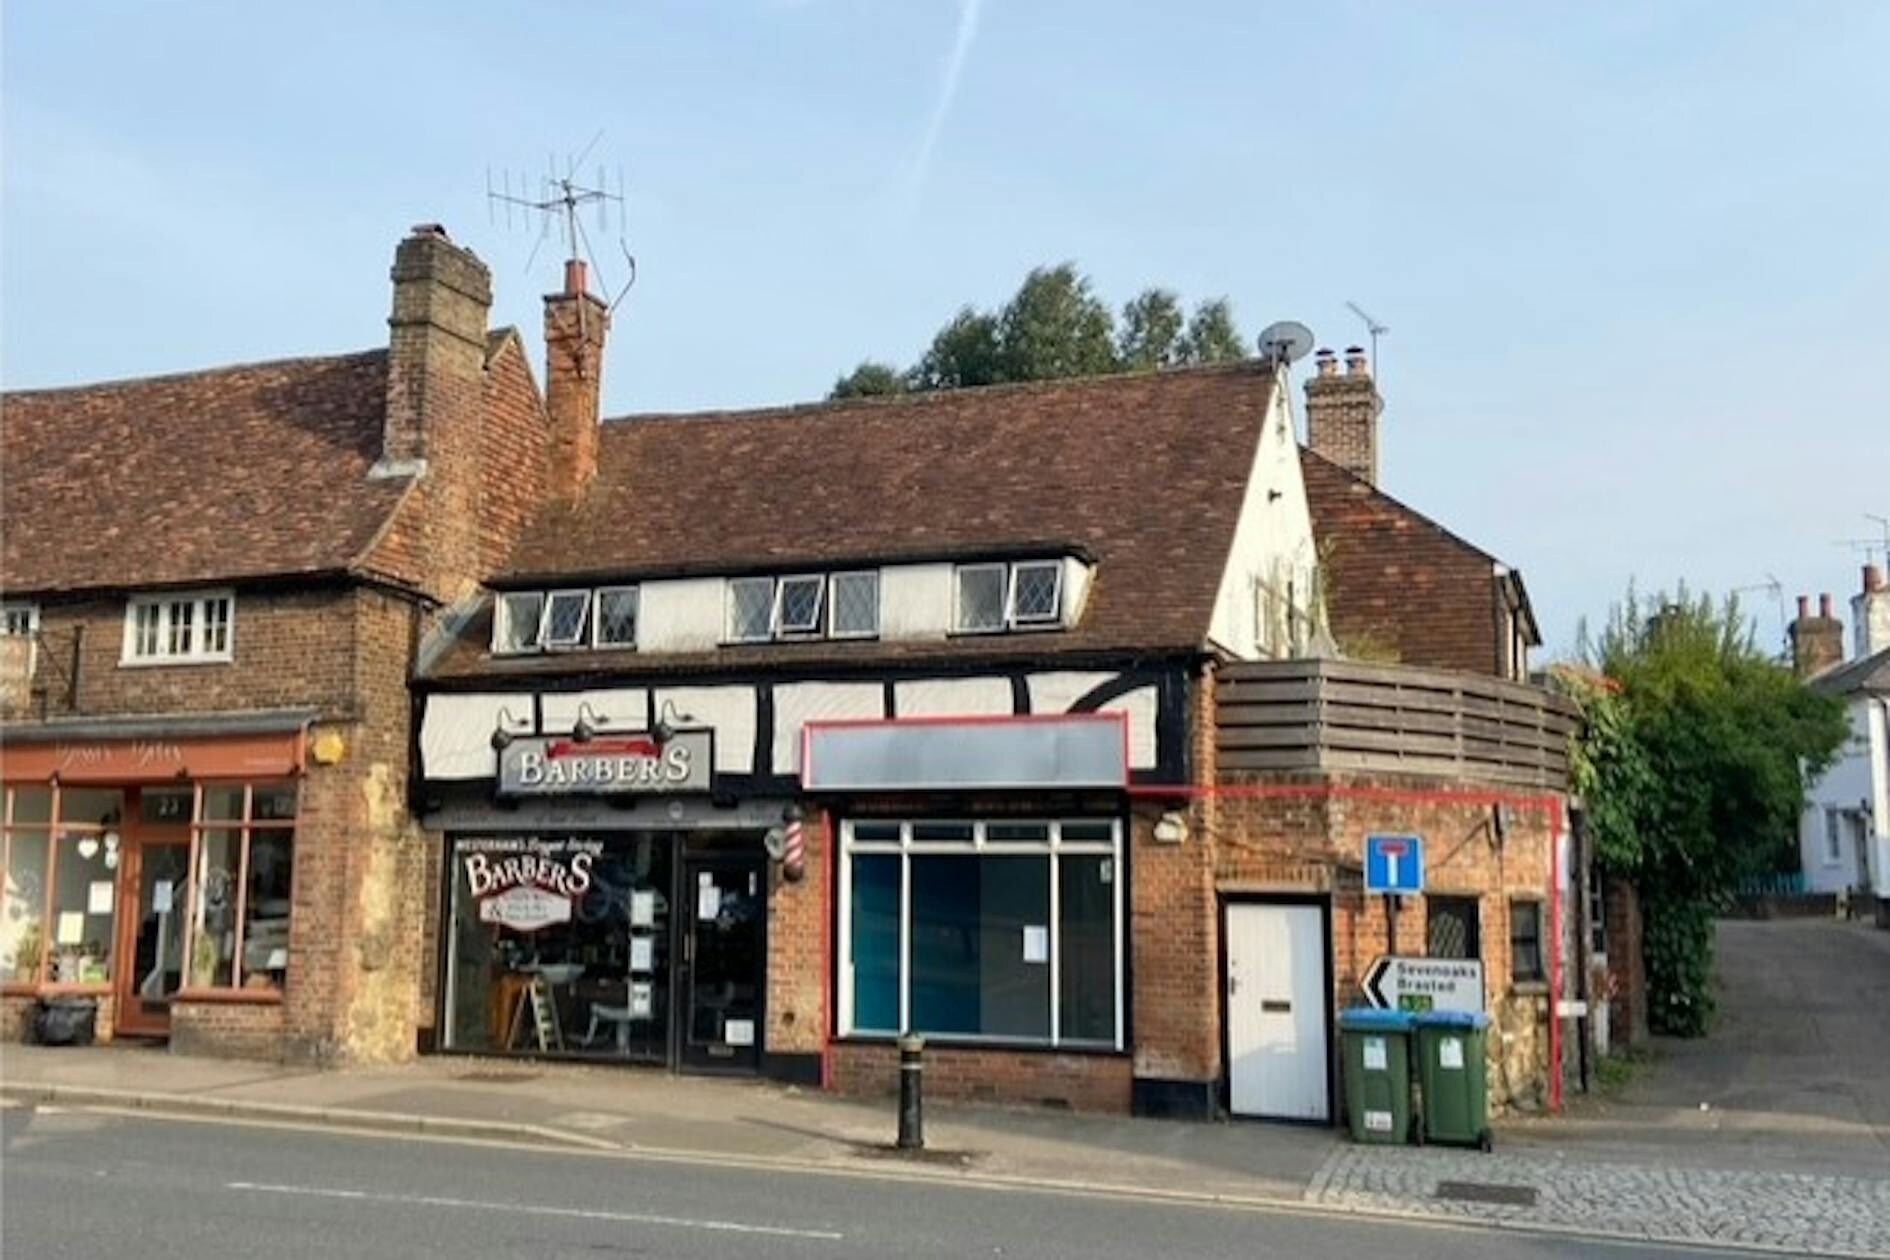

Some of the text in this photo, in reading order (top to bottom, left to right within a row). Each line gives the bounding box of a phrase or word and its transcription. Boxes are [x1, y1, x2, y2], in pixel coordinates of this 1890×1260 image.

[519, 746, 692, 785] BARBERS
[465, 851, 593, 897] BARBERS
[1397, 962, 1477, 979] Sevenoaks
[1397, 978, 1456, 993] Brasted
